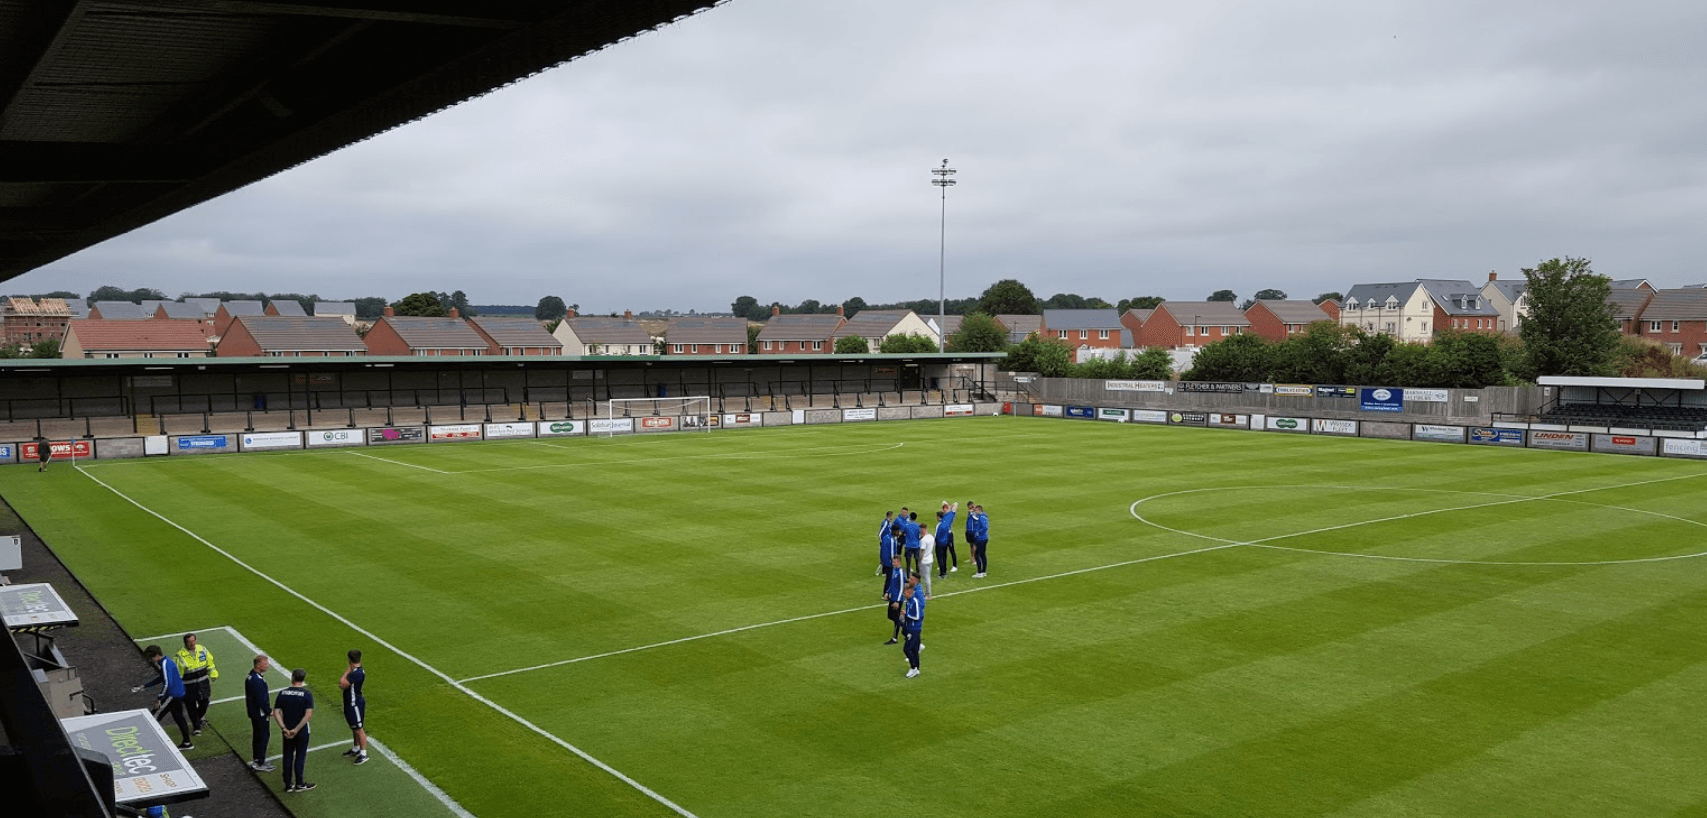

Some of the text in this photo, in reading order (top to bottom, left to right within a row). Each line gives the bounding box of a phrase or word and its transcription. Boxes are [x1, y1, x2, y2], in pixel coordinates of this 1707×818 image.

[591, 420, 612, 430] Salisbur
[334, 431, 349, 441] CBI
[1534, 432, 1574, 440] LINDEN
[1665, 443, 1699, 453] fencing
